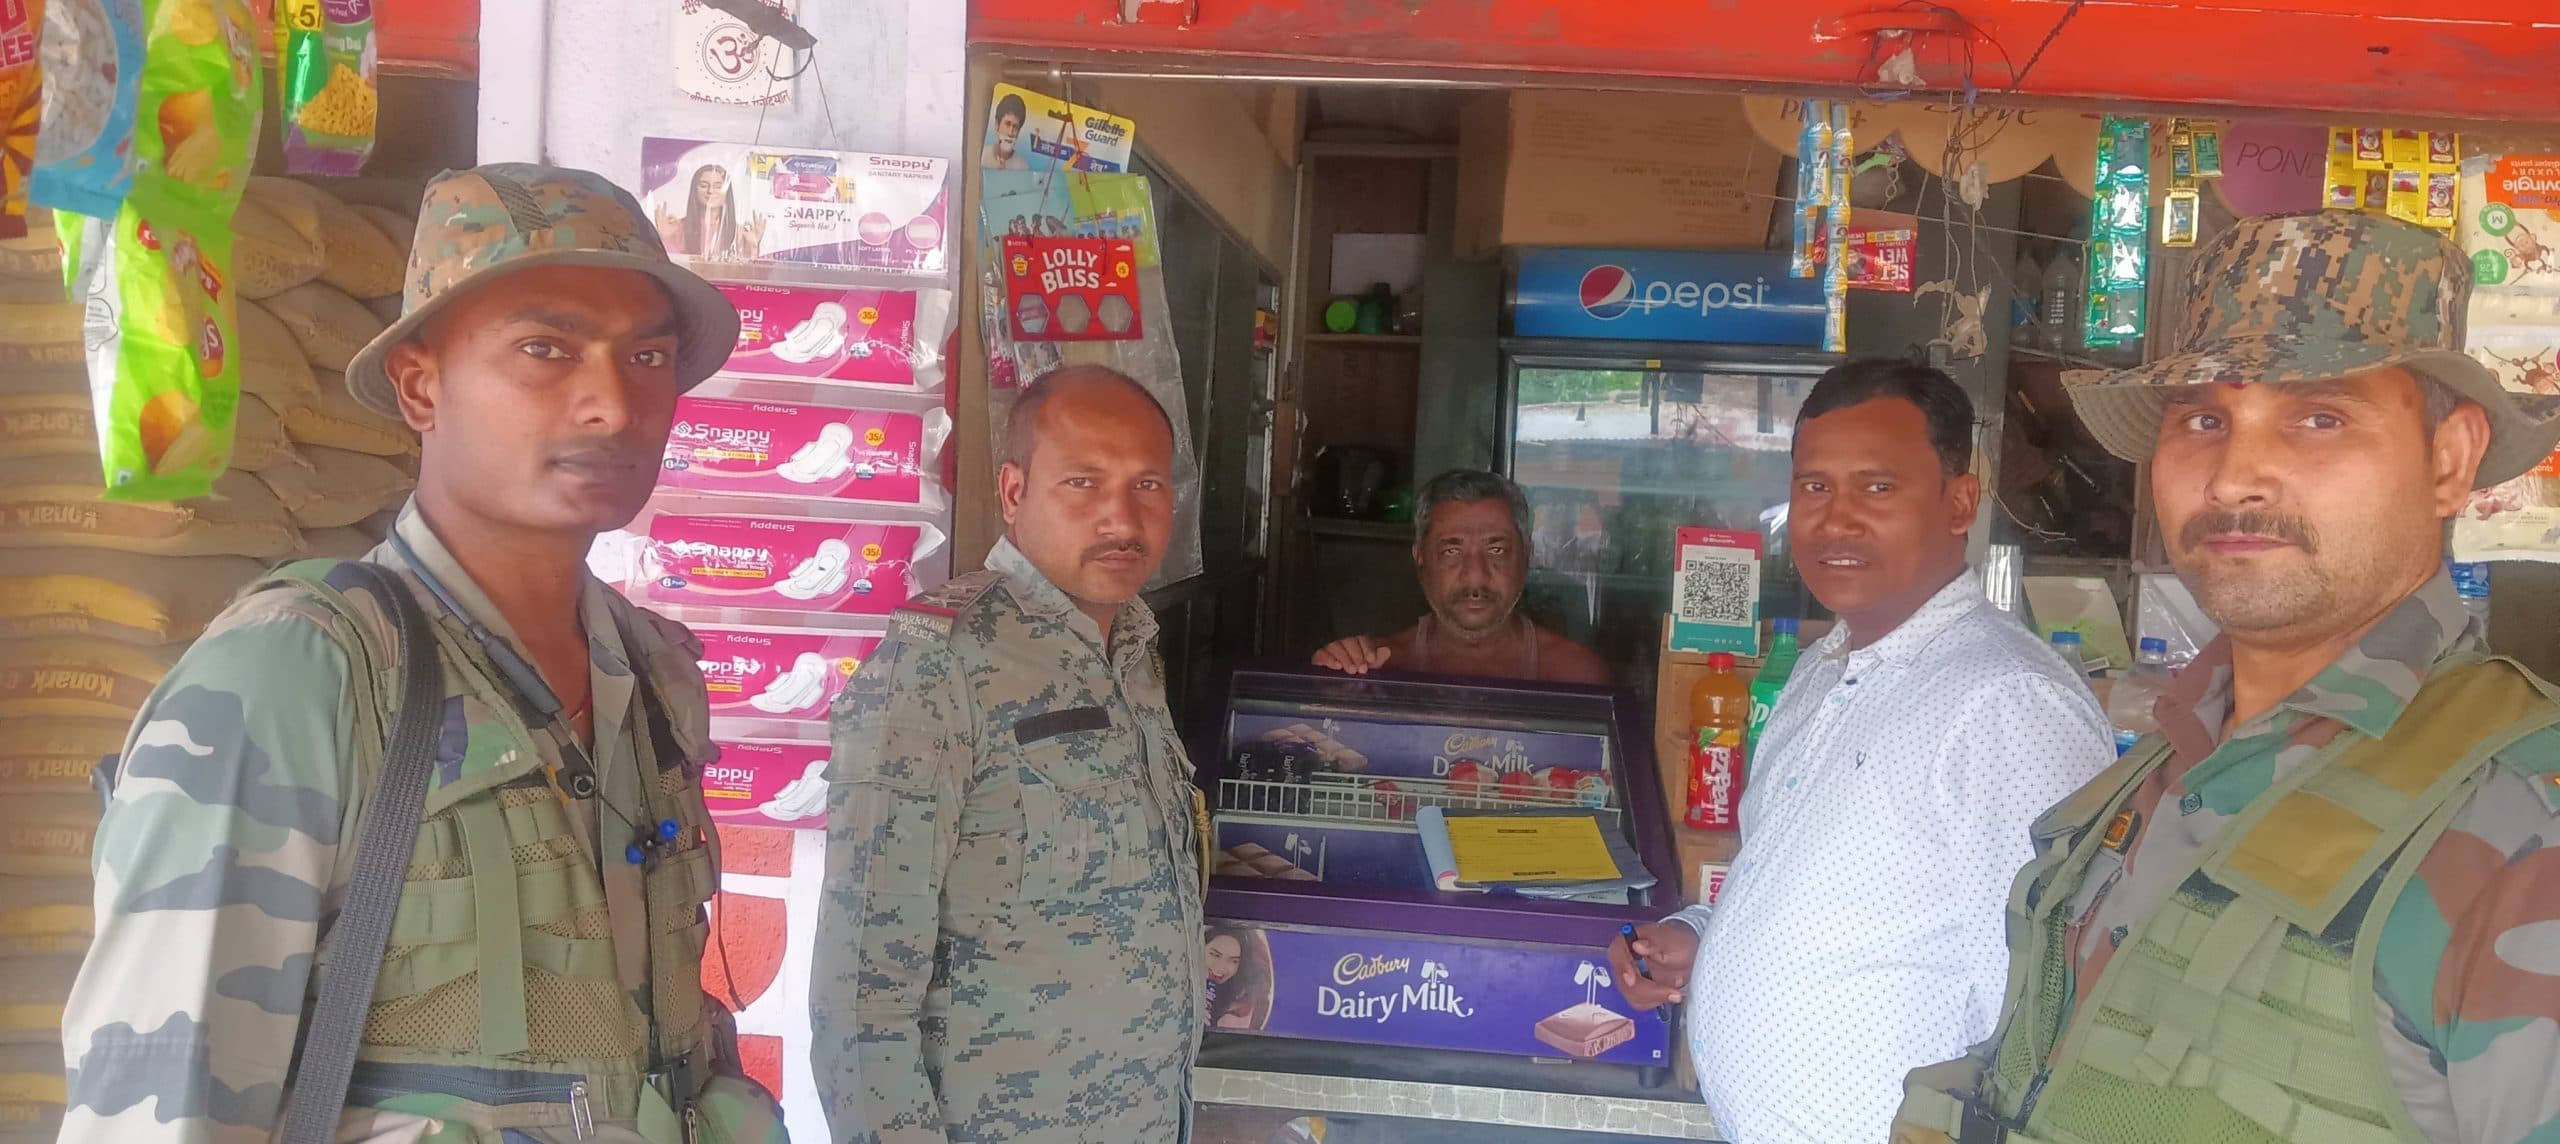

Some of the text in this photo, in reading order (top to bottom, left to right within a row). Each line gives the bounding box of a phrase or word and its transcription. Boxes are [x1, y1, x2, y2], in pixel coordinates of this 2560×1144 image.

[1085, 116, 1126, 137] Gillette
[1085, 130, 1119, 147] Guard
[869, 156, 930, 171] Snappy
[1042, 249, 1098, 270] LOLLY
[1878, 248, 1908, 264] WET
[1041, 268, 1099, 294] BLISS
[1880, 264, 1909, 280] SET
[746, 284, 790, 295] Snappy
[1644, 276, 1765, 317] pepsi
[752, 404, 798, 415] Snappy
[694, 423, 770, 444] Snappy
[17, 503, 99, 530] Konark
[750, 521, 795, 532] Snappy
[686, 541, 768, 562] Snappy
[662, 577, 672, 588] 6
[891, 611, 950, 633] JHARKHAND
[898, 623, 937, 641] POLICE
[726, 635, 772, 646] Snappy
[31, 669, 115, 700] Konark
[1749, 695, 1771, 729] Sp
[737, 744, 783, 754] Snappy
[27, 759, 92, 781] onark
[705, 767, 754, 782] appy
[1333, 953, 1410, 985] Cadbury
[1317, 983, 1474, 1023] Dairy Milk
